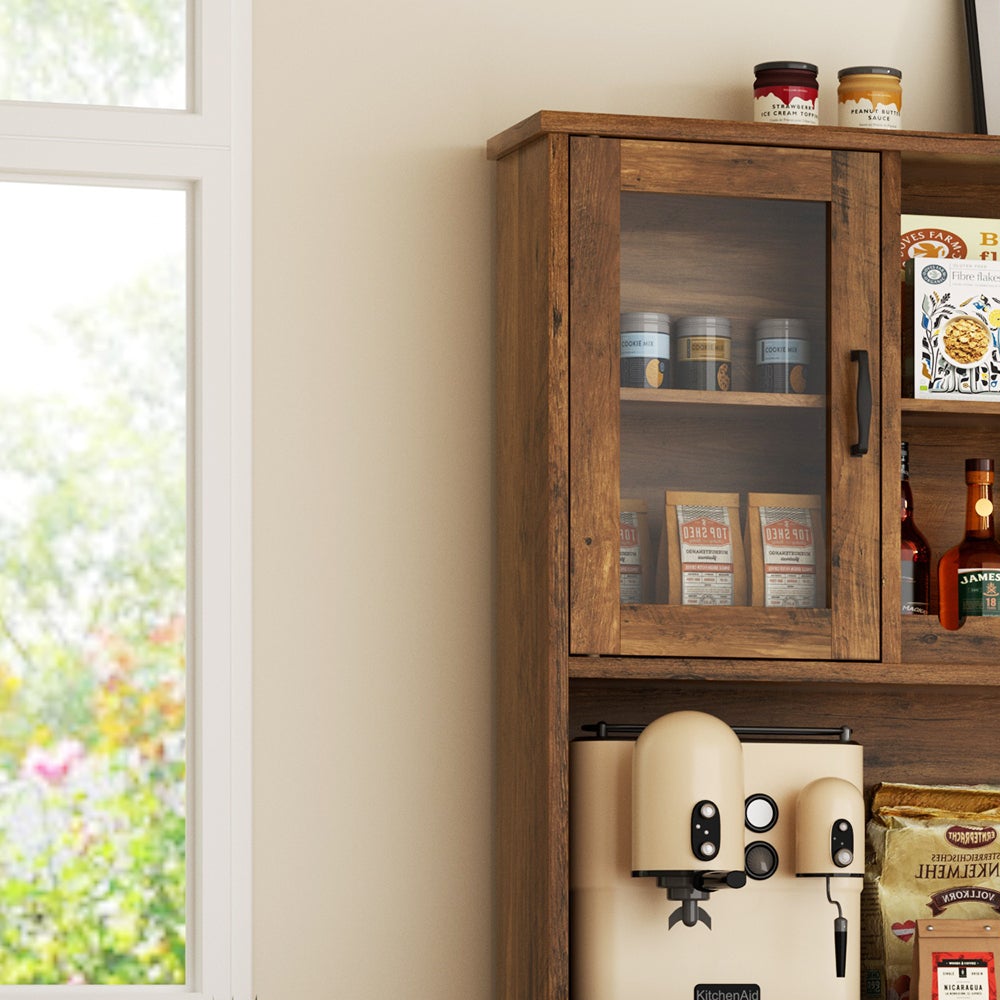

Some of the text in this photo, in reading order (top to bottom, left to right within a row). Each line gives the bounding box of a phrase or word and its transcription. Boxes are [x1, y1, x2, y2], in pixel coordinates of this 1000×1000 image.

[929, 231, 962, 249] FARM
[952, 271, 975, 281] Fibre
[986, 597, 997, 607] 18
